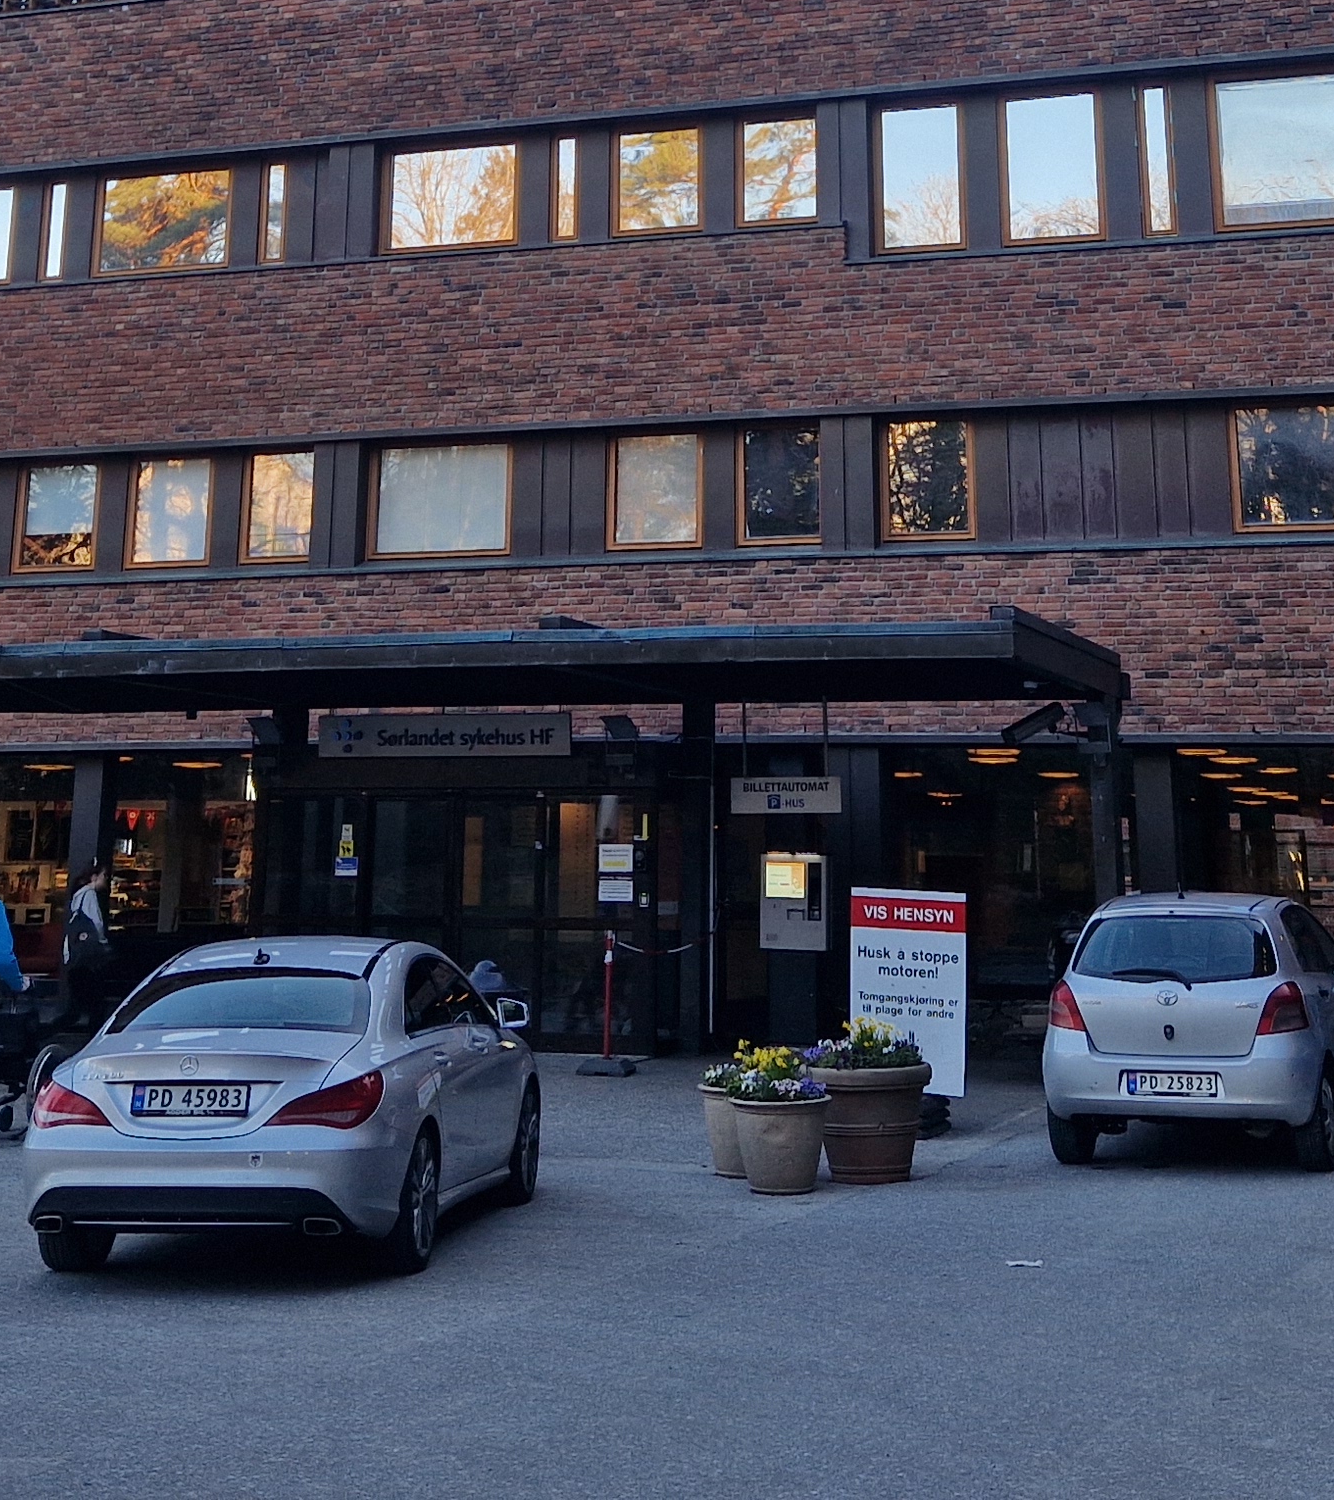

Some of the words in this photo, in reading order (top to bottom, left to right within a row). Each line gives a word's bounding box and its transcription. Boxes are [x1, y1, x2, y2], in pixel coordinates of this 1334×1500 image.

[376, 727, 455, 747] Sørlandet
[459, 726, 526, 750] sykehus
[529, 728, 555, 745] HF
[742, 781, 830, 793] BILLETTAUTOMAT
[863, 904, 888, 920] VIS
[893, 906, 954, 924] HENSYN
[857, 945, 891, 960] Husk
[911, 949, 960, 966] stoppe
[878, 965, 939, 979] motoren!
[858, 990, 945, 1008] Tomgangskjøring
[948, 999, 959, 1008] er
[862, 1003, 872, 1013] til
[875, 1005, 904, 1018] plage
[907, 1006, 923, 1017] for
[926, 1008, 955, 1020] andre
[1139, 1075, 1158, 1089] PD
[1167, 1075, 1213, 1091] 25823
[147, 1088, 174, 1108] PD
[181, 1088, 242, 1108] 45983
